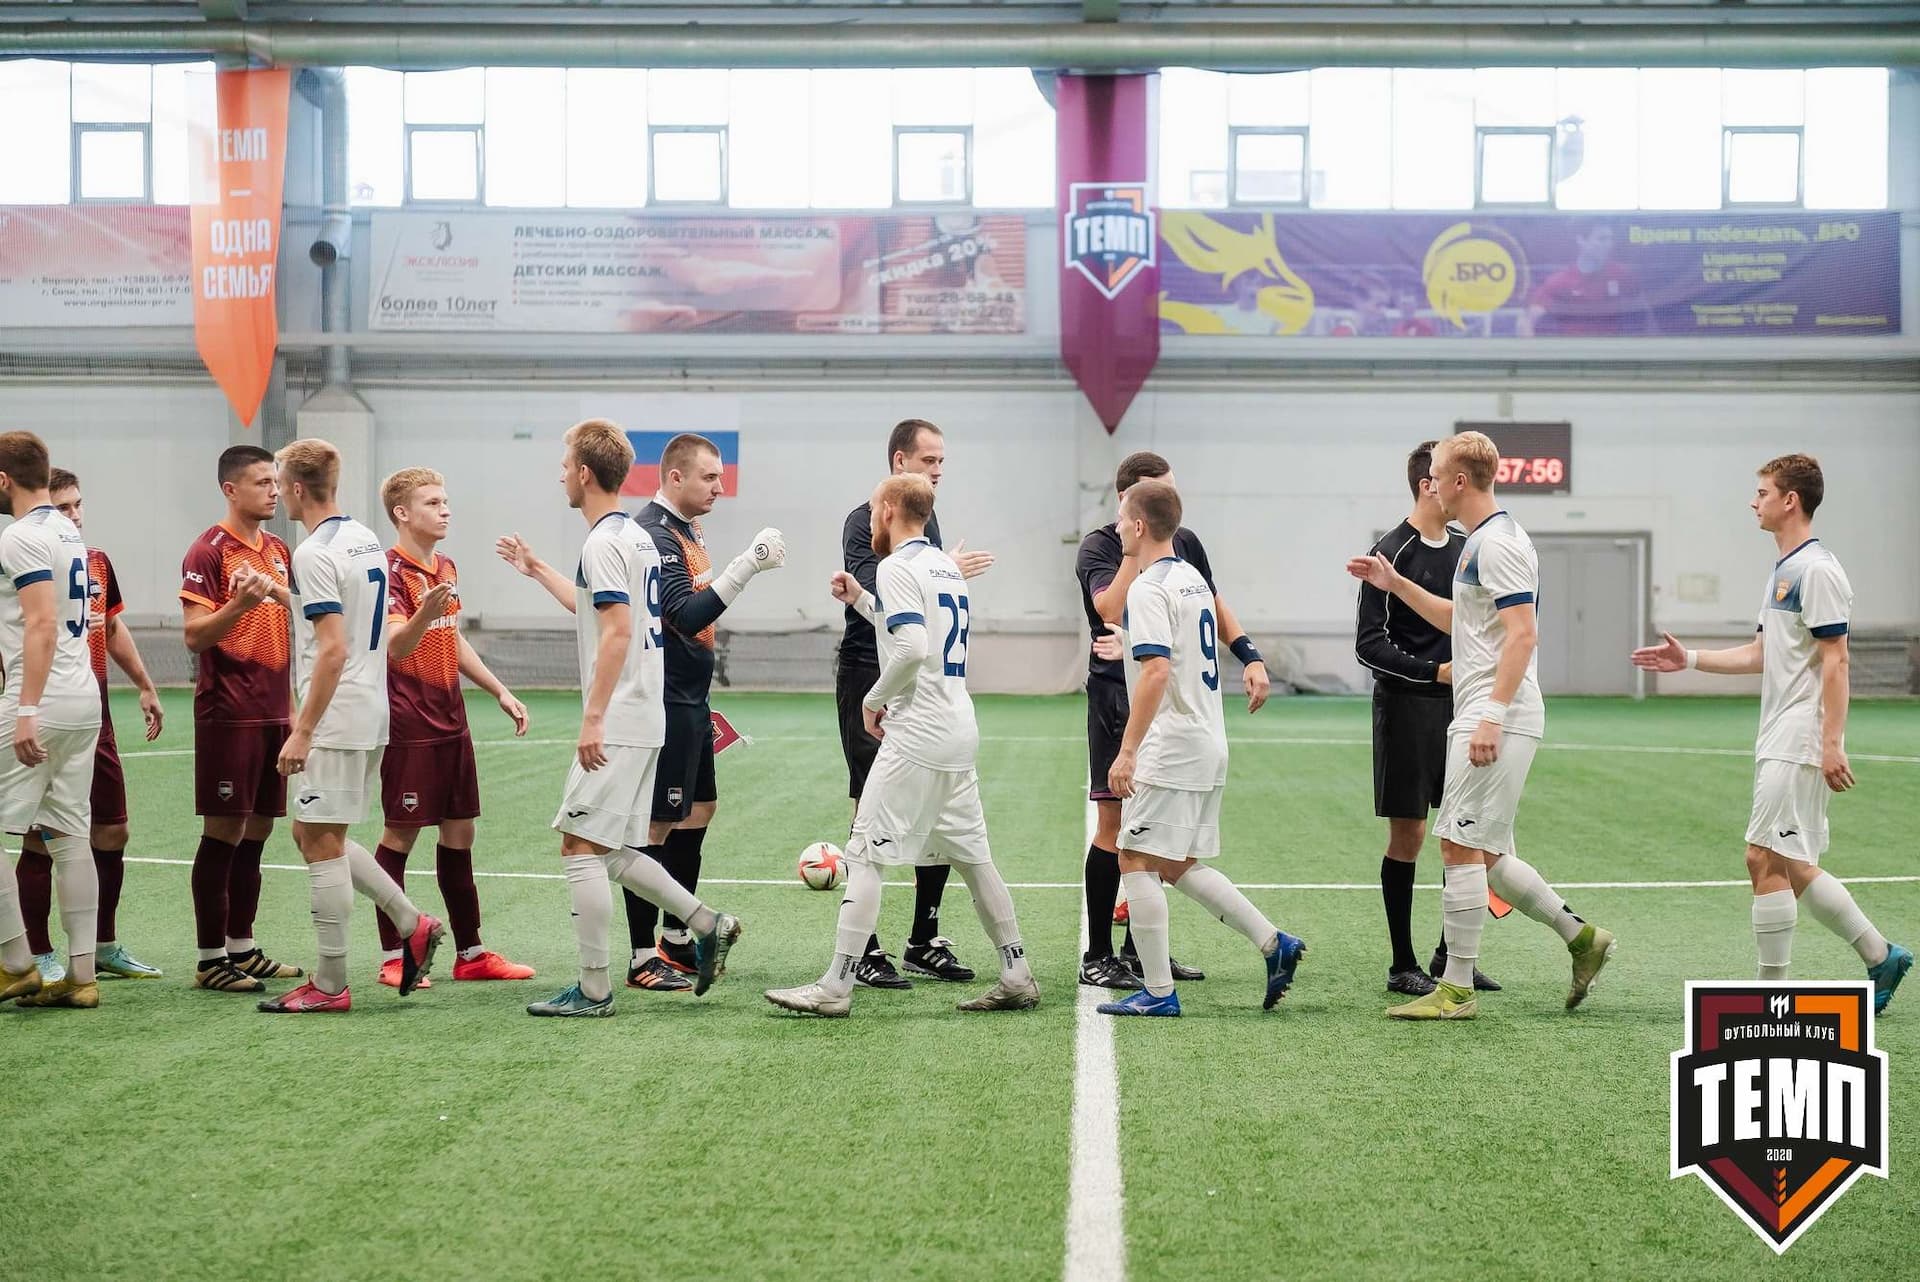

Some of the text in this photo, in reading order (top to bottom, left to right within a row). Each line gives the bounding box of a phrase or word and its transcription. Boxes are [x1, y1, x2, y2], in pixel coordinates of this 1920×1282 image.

[210, 219, 271, 258] ОДНА
[1073, 215, 1148, 256] ТЕМП
[203, 263, 273, 299] СЕМЬЯ
[514, 263, 587, 278] ДЕТСКИЙ
[382, 296, 438, 311] более
[367, 567, 386, 650] 7
[1199, 608, 1219, 692] 9
